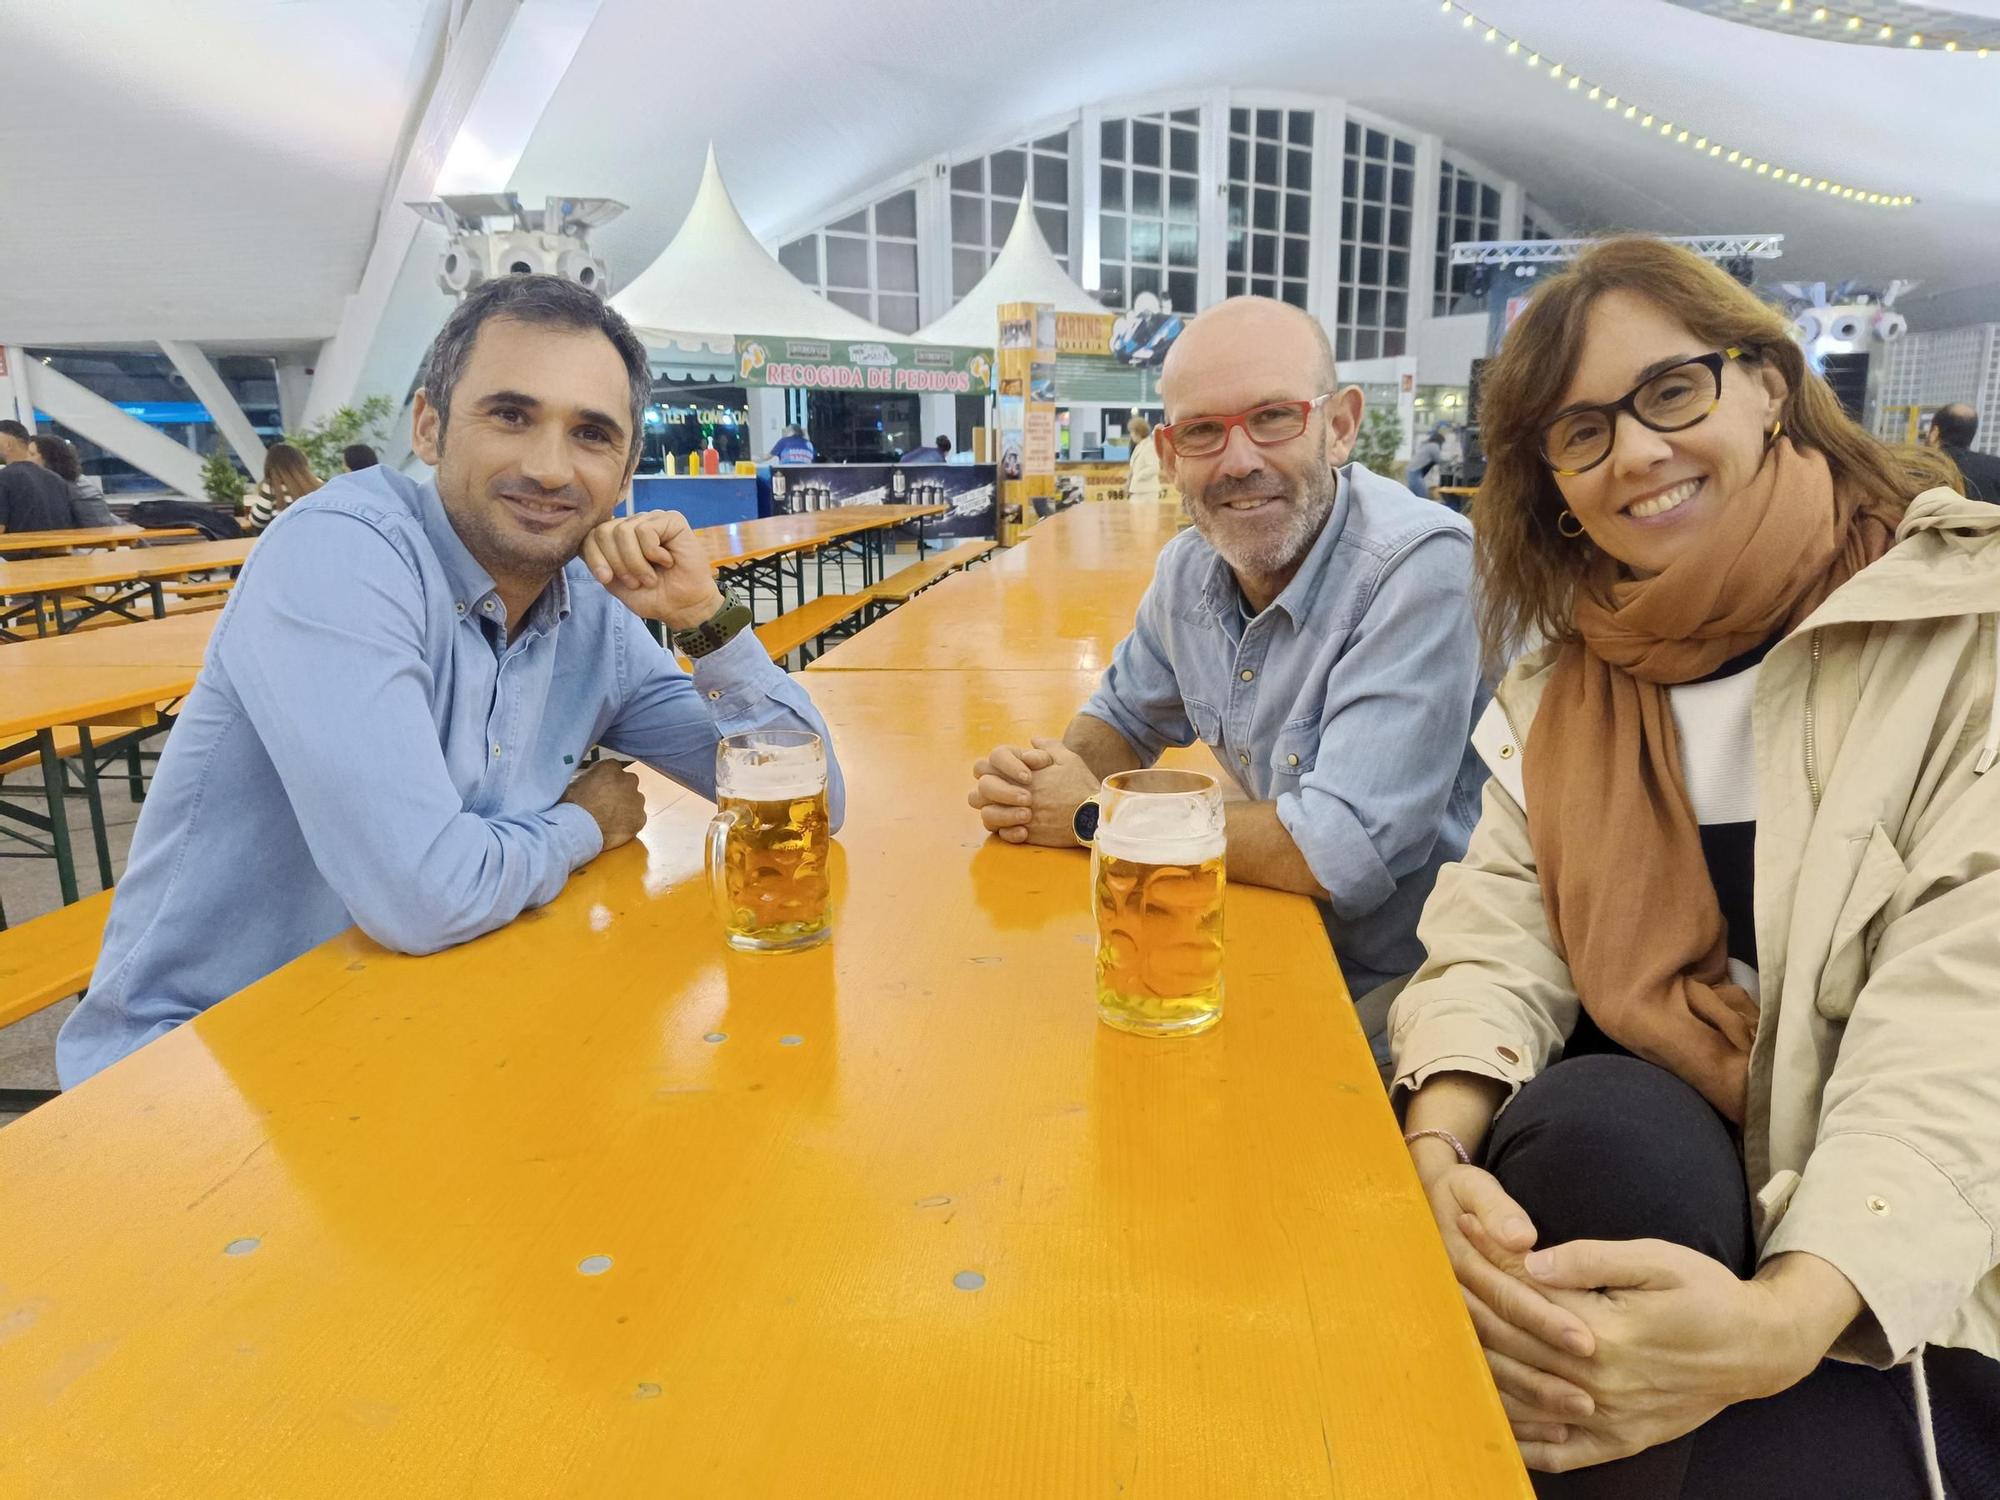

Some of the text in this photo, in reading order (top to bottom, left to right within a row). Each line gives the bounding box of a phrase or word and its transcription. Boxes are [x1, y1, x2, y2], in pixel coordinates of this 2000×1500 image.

[767, 363, 970, 392] RECOGIDA DE PEDIDOS
